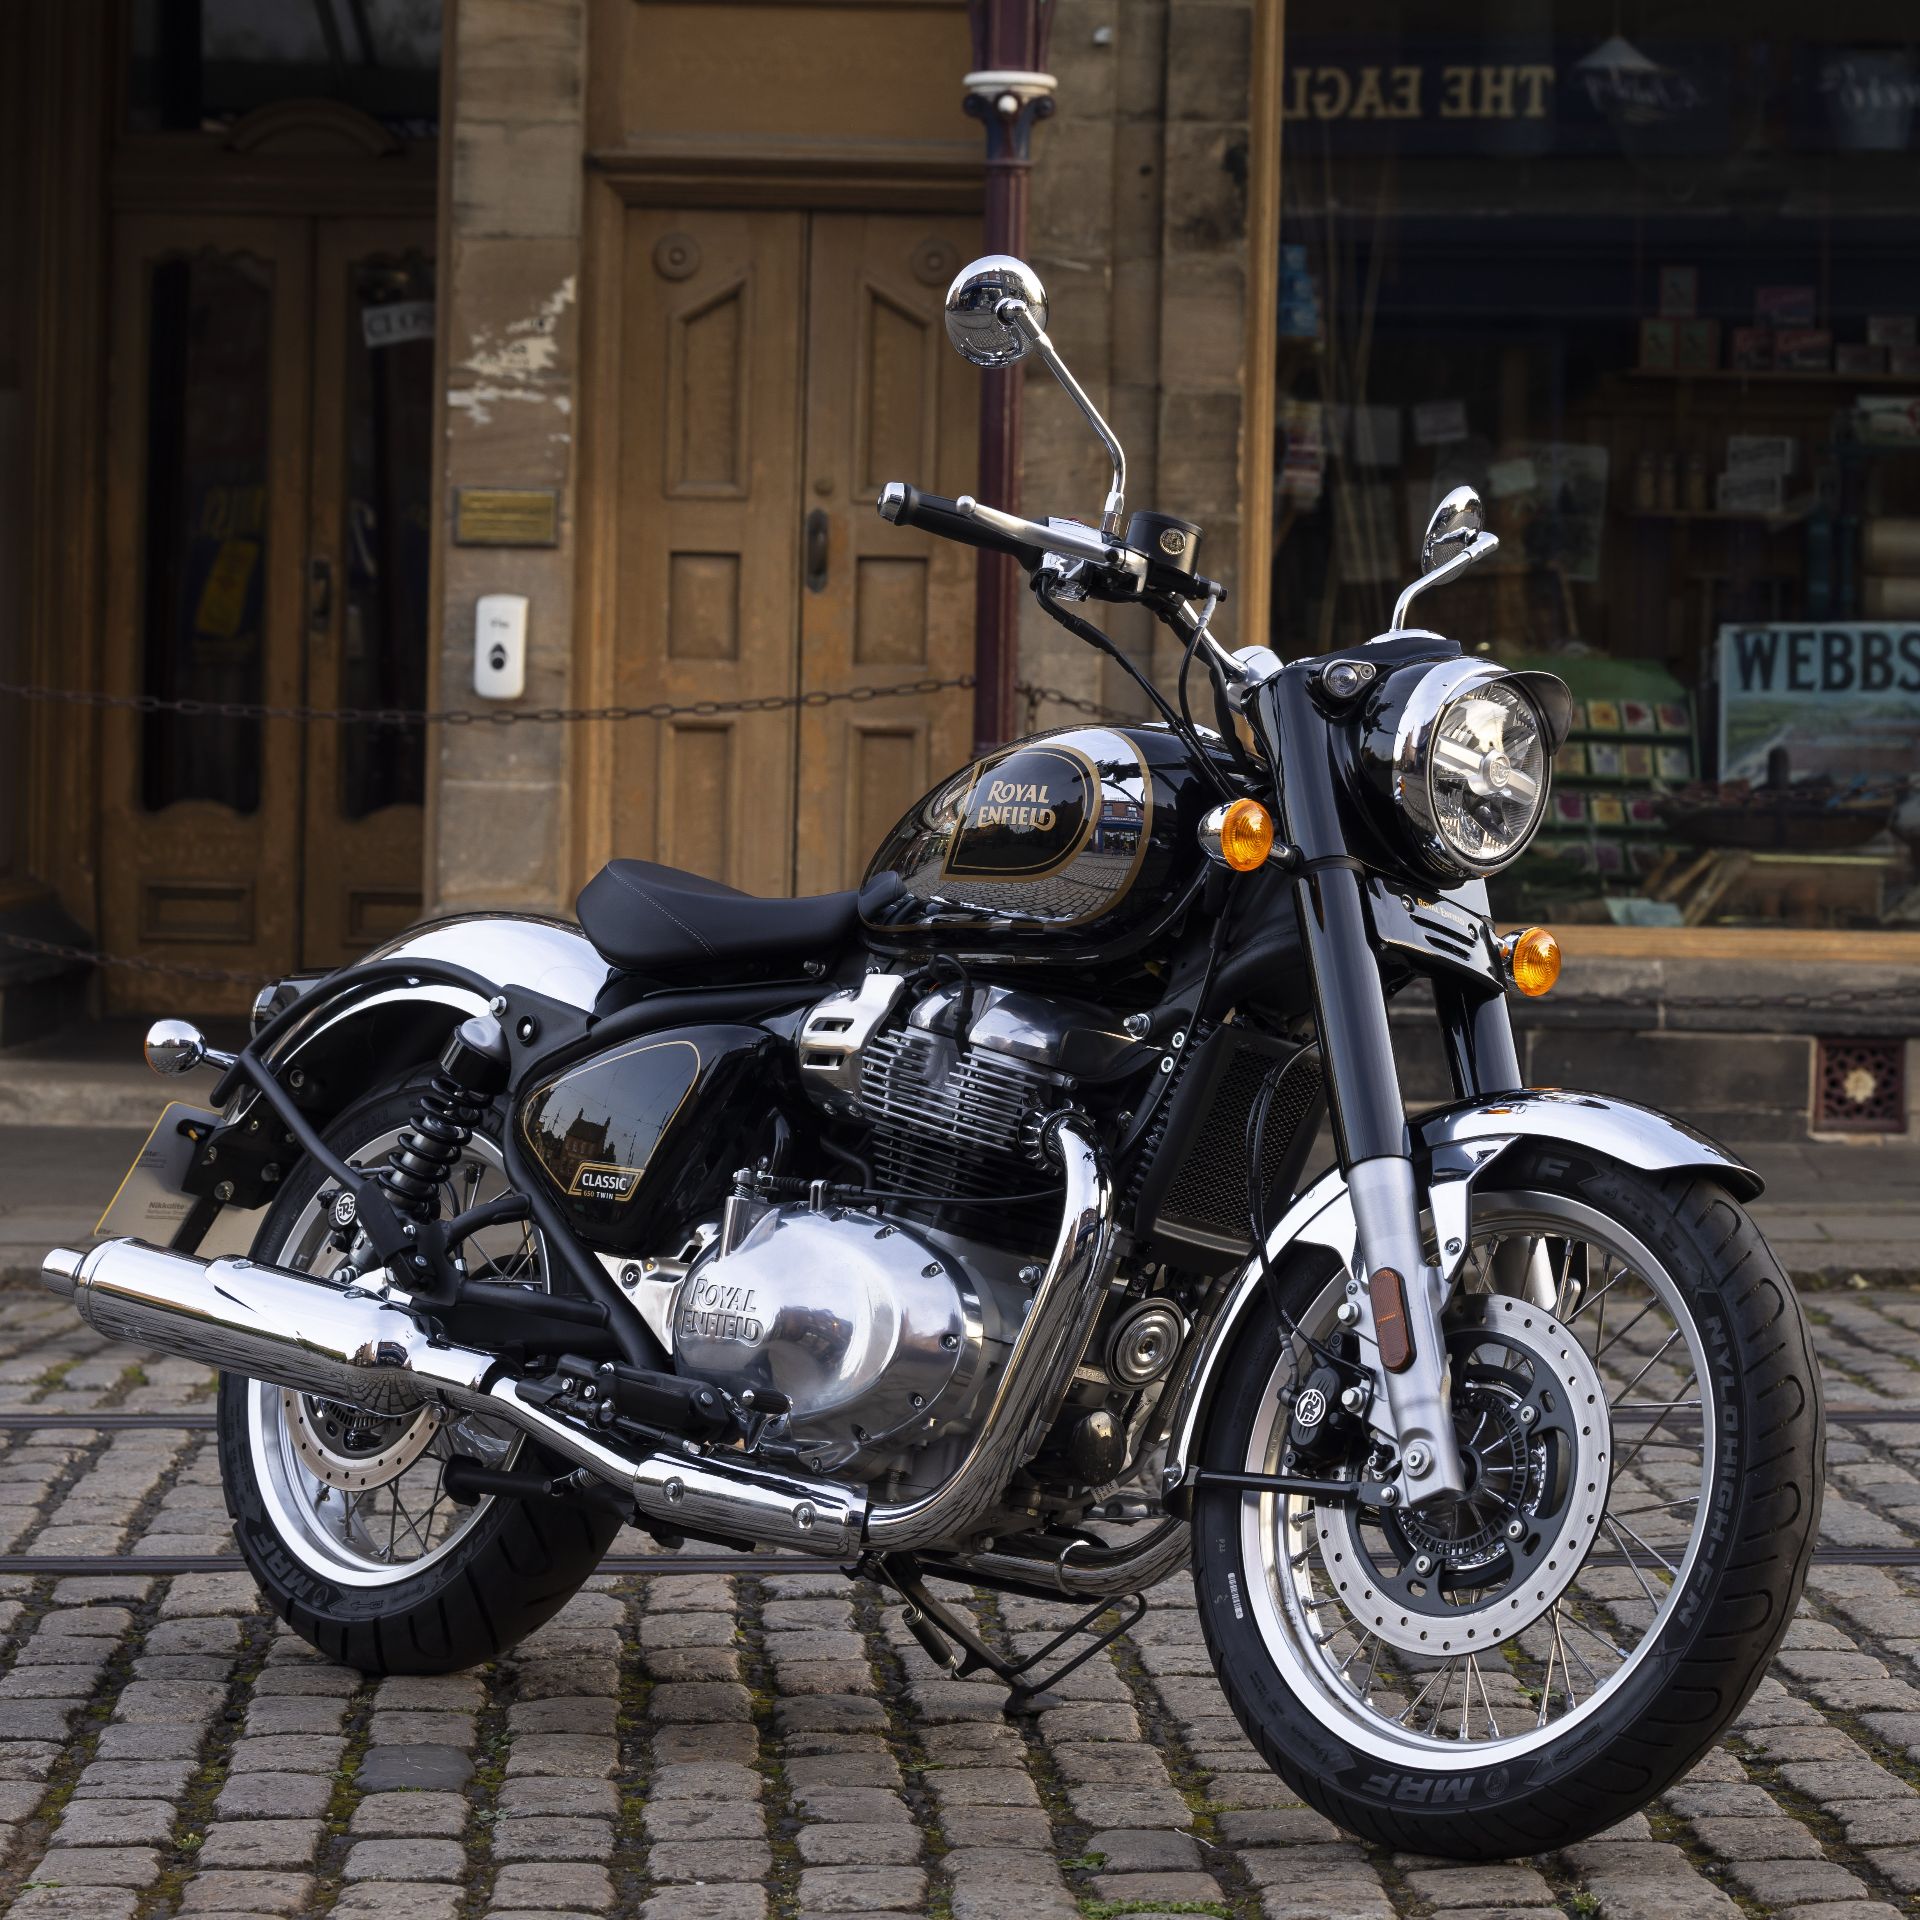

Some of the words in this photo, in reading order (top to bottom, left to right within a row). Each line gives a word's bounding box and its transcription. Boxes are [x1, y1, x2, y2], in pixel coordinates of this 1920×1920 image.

[987, 780, 1049, 804] ROYAL
[978, 805, 1056, 831] ENFIELD
[582, 1173, 627, 1191] CLASSIC
[583, 1190, 595, 1198] 650
[596, 1191, 614, 1200] TWIN
[690, 1278, 757, 1312] ROYAL
[680, 1310, 764, 1347] ENFIELD
[251, 1533, 315, 1598] MRF
[1360, 1772, 1476, 1804] MRF
